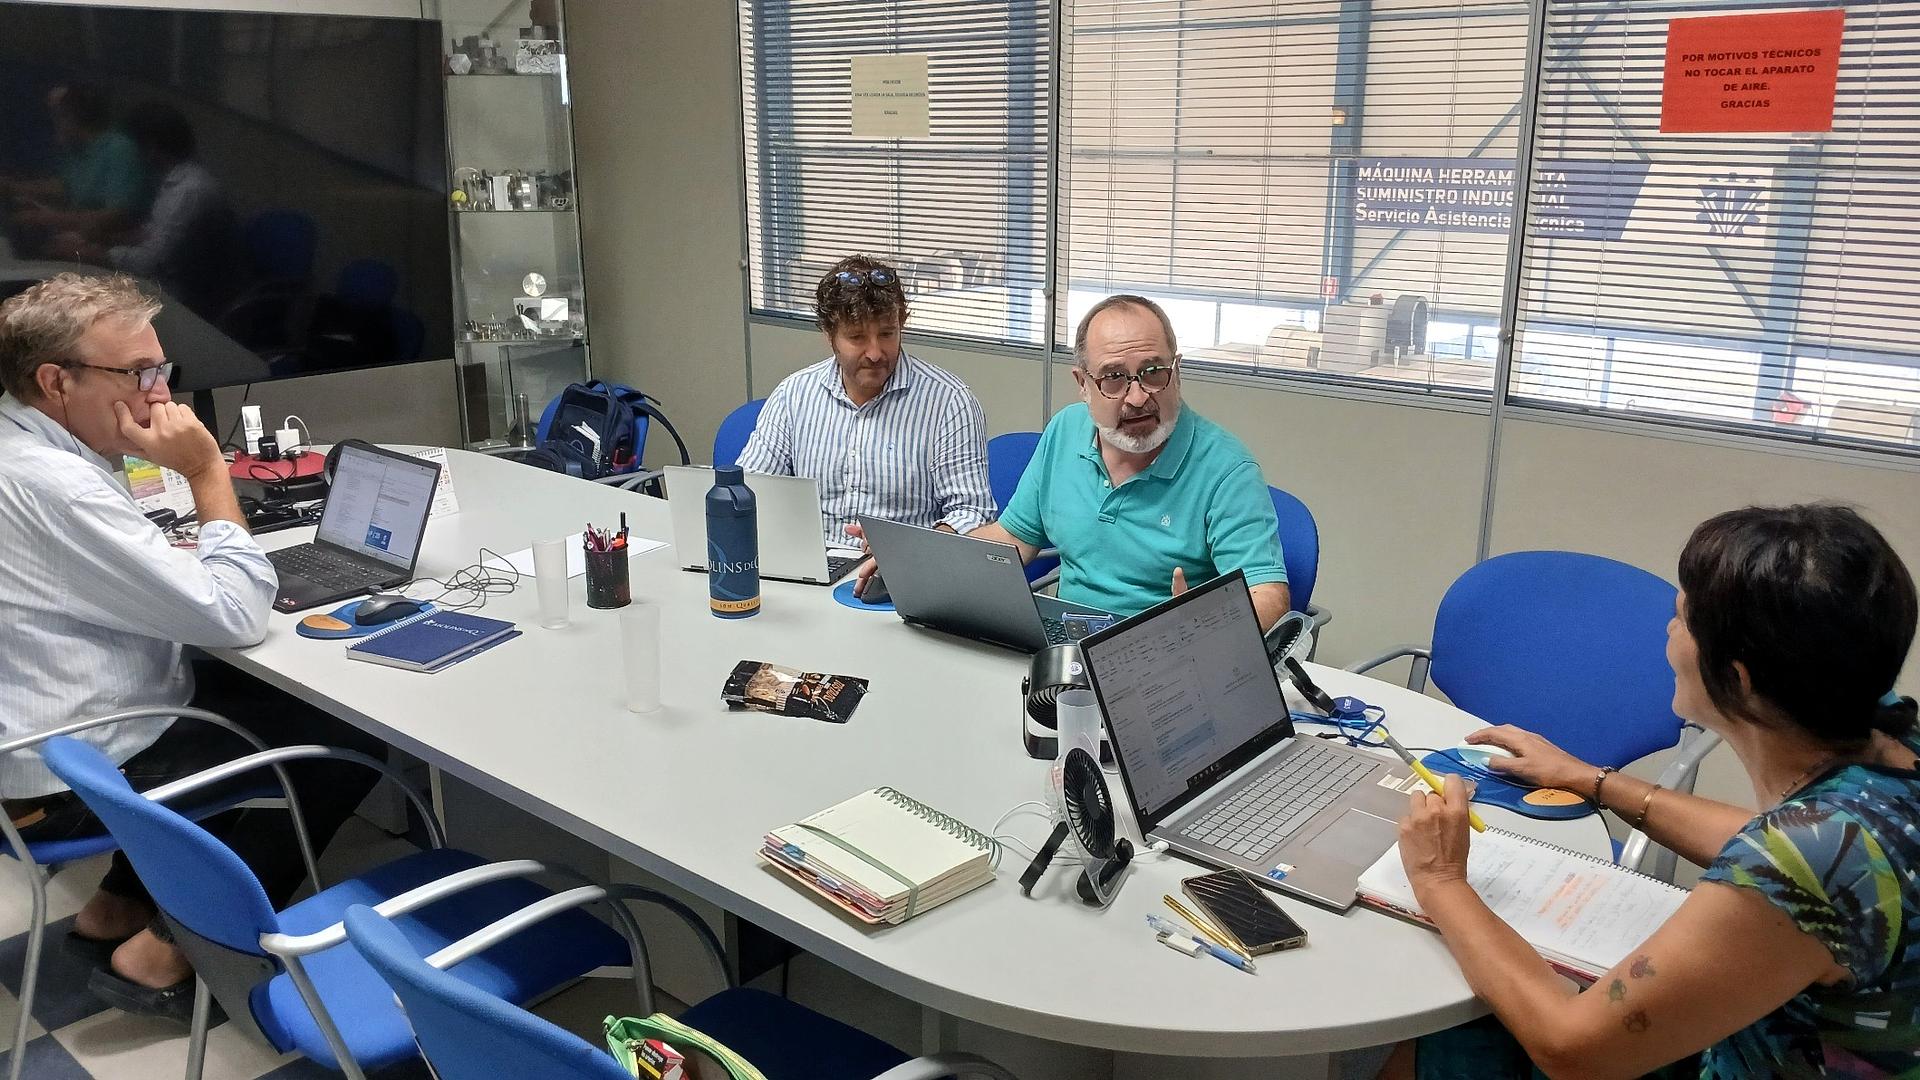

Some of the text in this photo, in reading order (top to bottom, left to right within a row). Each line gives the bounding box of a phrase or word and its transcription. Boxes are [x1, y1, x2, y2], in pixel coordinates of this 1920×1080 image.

[1682, 54, 1705, 63] POR
[1707, 51, 1758, 61] MOTIVOS
[1685, 64, 1815, 78] NO TOCAR EL APARATO
[1723, 82, 1770, 92] DE AIRE.
[1720, 99, 1770, 109] GRACIAS
[1358, 162, 1434, 183] MÁQUINA
[1356, 187, 1458, 205] SUMINISTRO
[1355, 202, 1420, 224] Servicio
[1424, 205, 1511, 229] Asistencia
